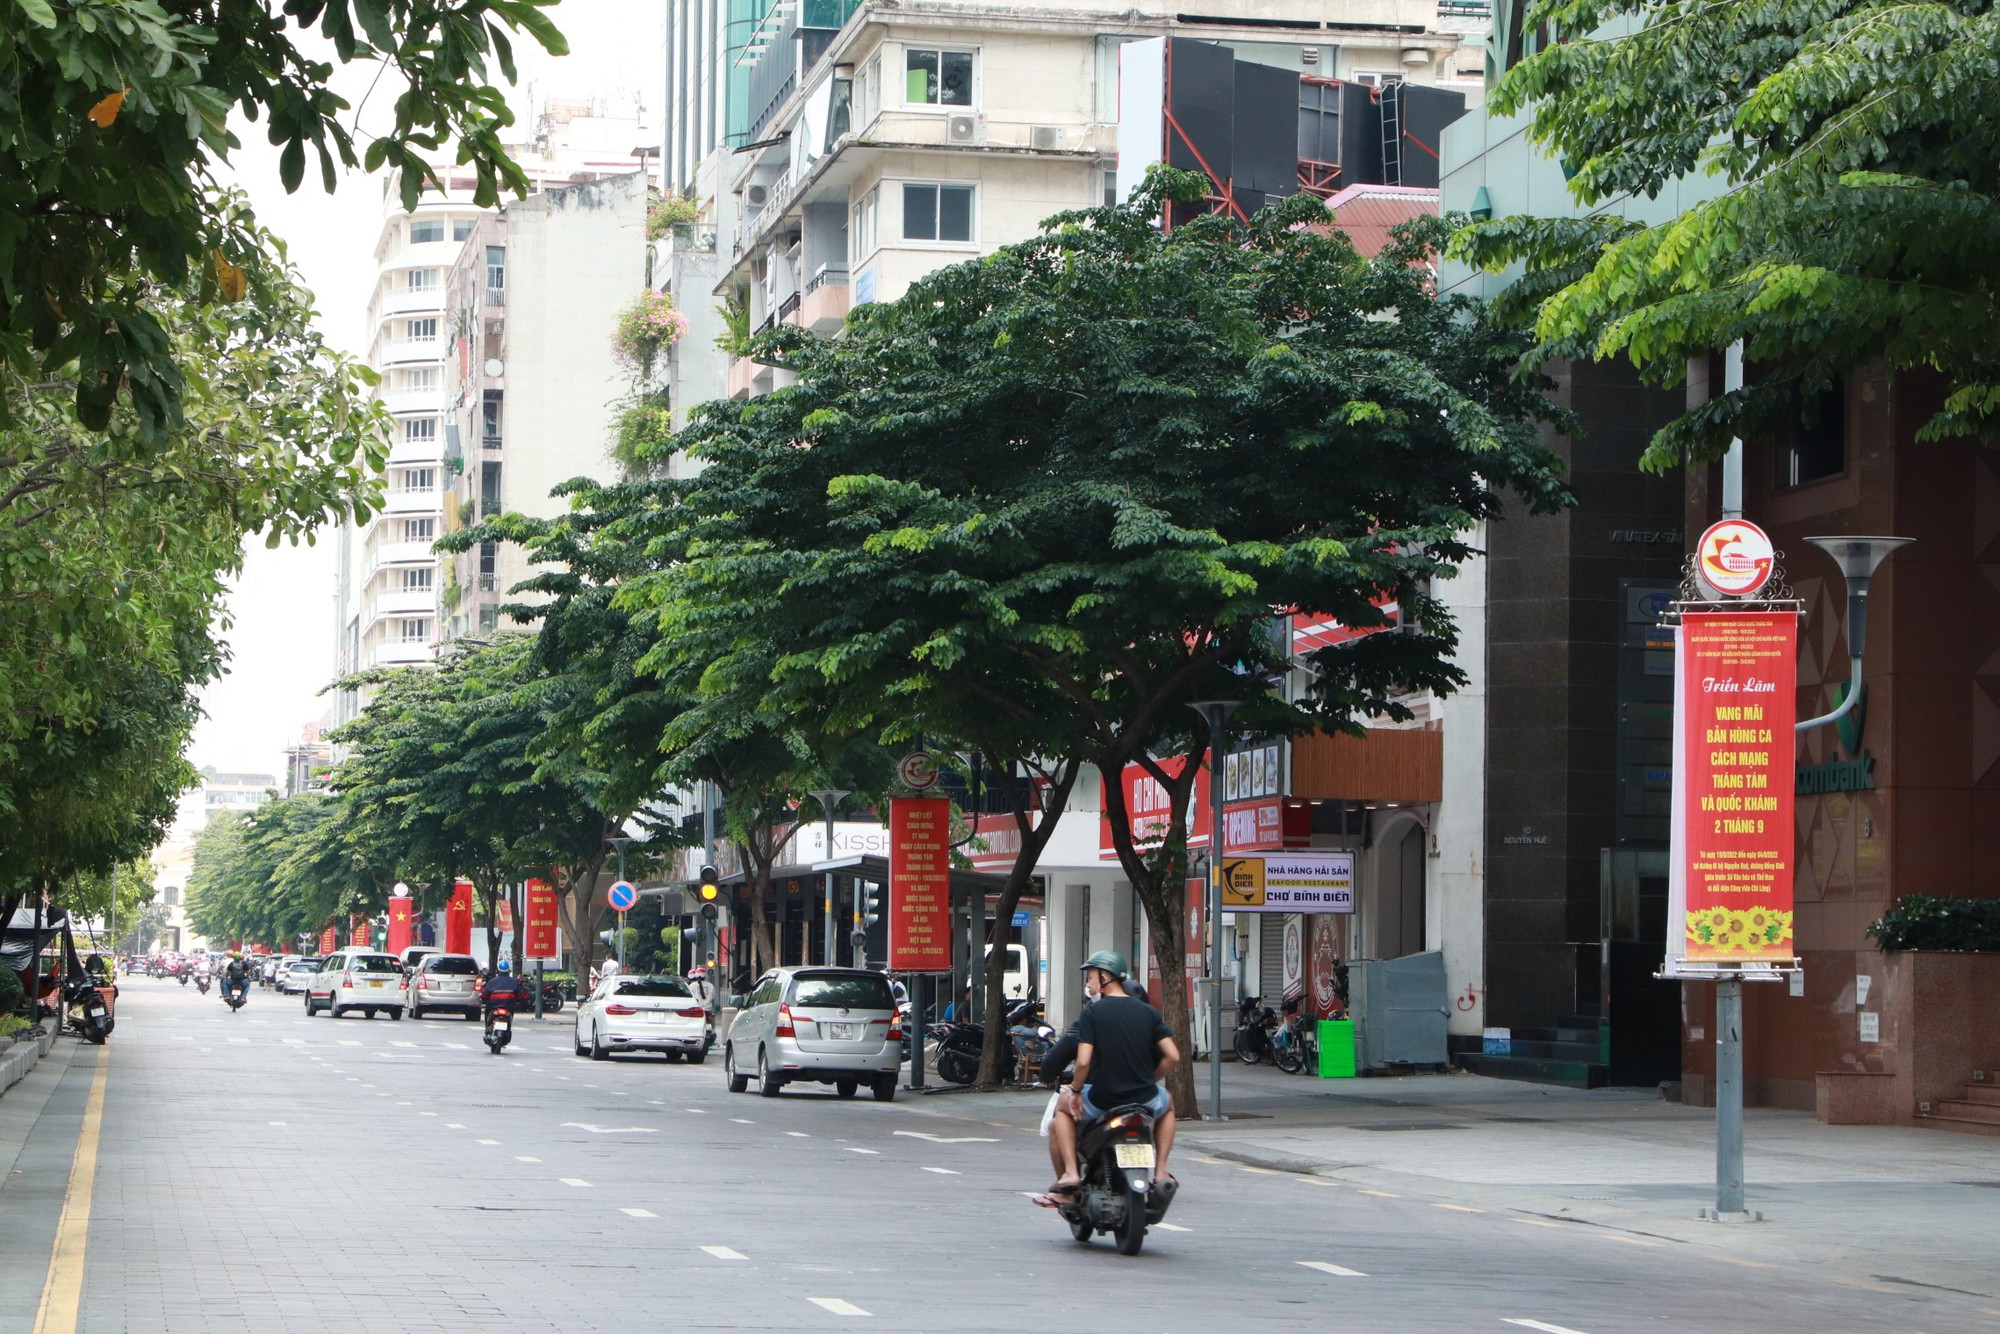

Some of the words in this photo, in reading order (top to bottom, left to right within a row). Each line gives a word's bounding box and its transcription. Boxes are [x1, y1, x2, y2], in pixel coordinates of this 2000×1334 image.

[1702, 677, 1739, 693] Triển
[1743, 677, 1776, 693] Lãm
[1716, 707, 1741, 720] VANG
[1744, 704, 1763, 720] MÃI
[1707, 725, 1726, 743] BẢN
[1730, 727, 1756, 743] HÙNG
[1759, 729, 1772, 743] CA
[1711, 749, 1736, 766] CÁCH
[1739, 752, 1768, 769] MẠNG
[1712, 772, 1743, 788] THÁNG
[1746, 772, 1767, 788] TÁM
[1701, 794, 1714, 811] VÀ
[1716, 792, 1741, 812] QUỐC
[1745, 794, 1777, 811] KHÁNH
[1715, 820, 1721, 833] 2
[1723, 817, 1754, 833] THÁNG
[1757, 820, 1764, 833] 9
[1268, 865, 1285, 875] NHÀ
[1288, 866, 1312, 875] HÀNG
[1315, 866, 1329, 875] HẢI
[1332, 866, 1349, 876] SẢN
[1266, 890, 1290, 902] CHỢ
